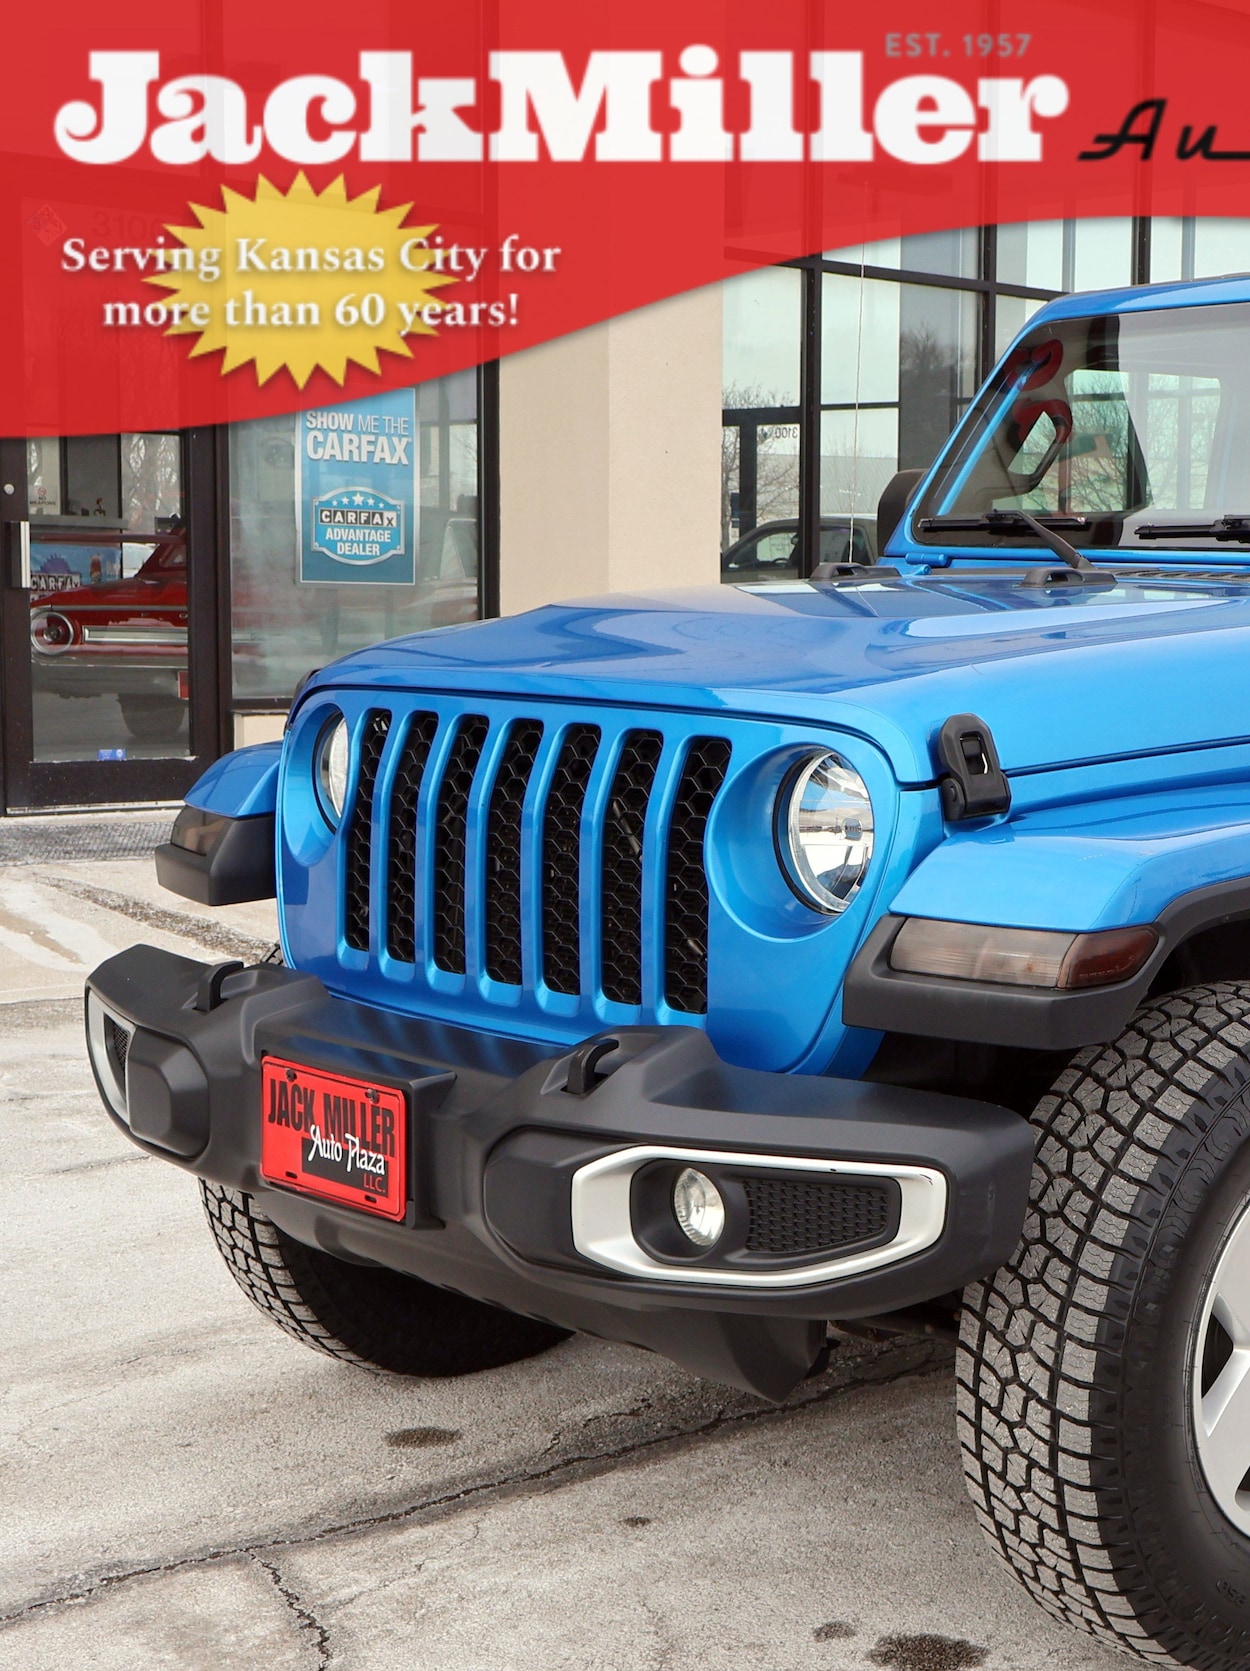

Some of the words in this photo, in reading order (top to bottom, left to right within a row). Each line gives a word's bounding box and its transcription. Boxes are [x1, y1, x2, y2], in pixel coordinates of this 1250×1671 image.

[306, 411, 354, 431] SHOW
[358, 414, 380, 433] ME
[382, 416, 409, 435] THE
[306, 430, 409, 465] CARFAX
[320, 509, 397, 527] CARFAX
[325, 528, 392, 543] ADVANTAGE
[336, 542, 381, 557] DEALER
[268, 1078, 316, 1134] JACK
[323, 1092, 396, 1157] MILLER
[308, 1124, 343, 1162] Auto
[345, 1132, 386, 1175] Plaza
[363, 1173, 387, 1193] LLC.
